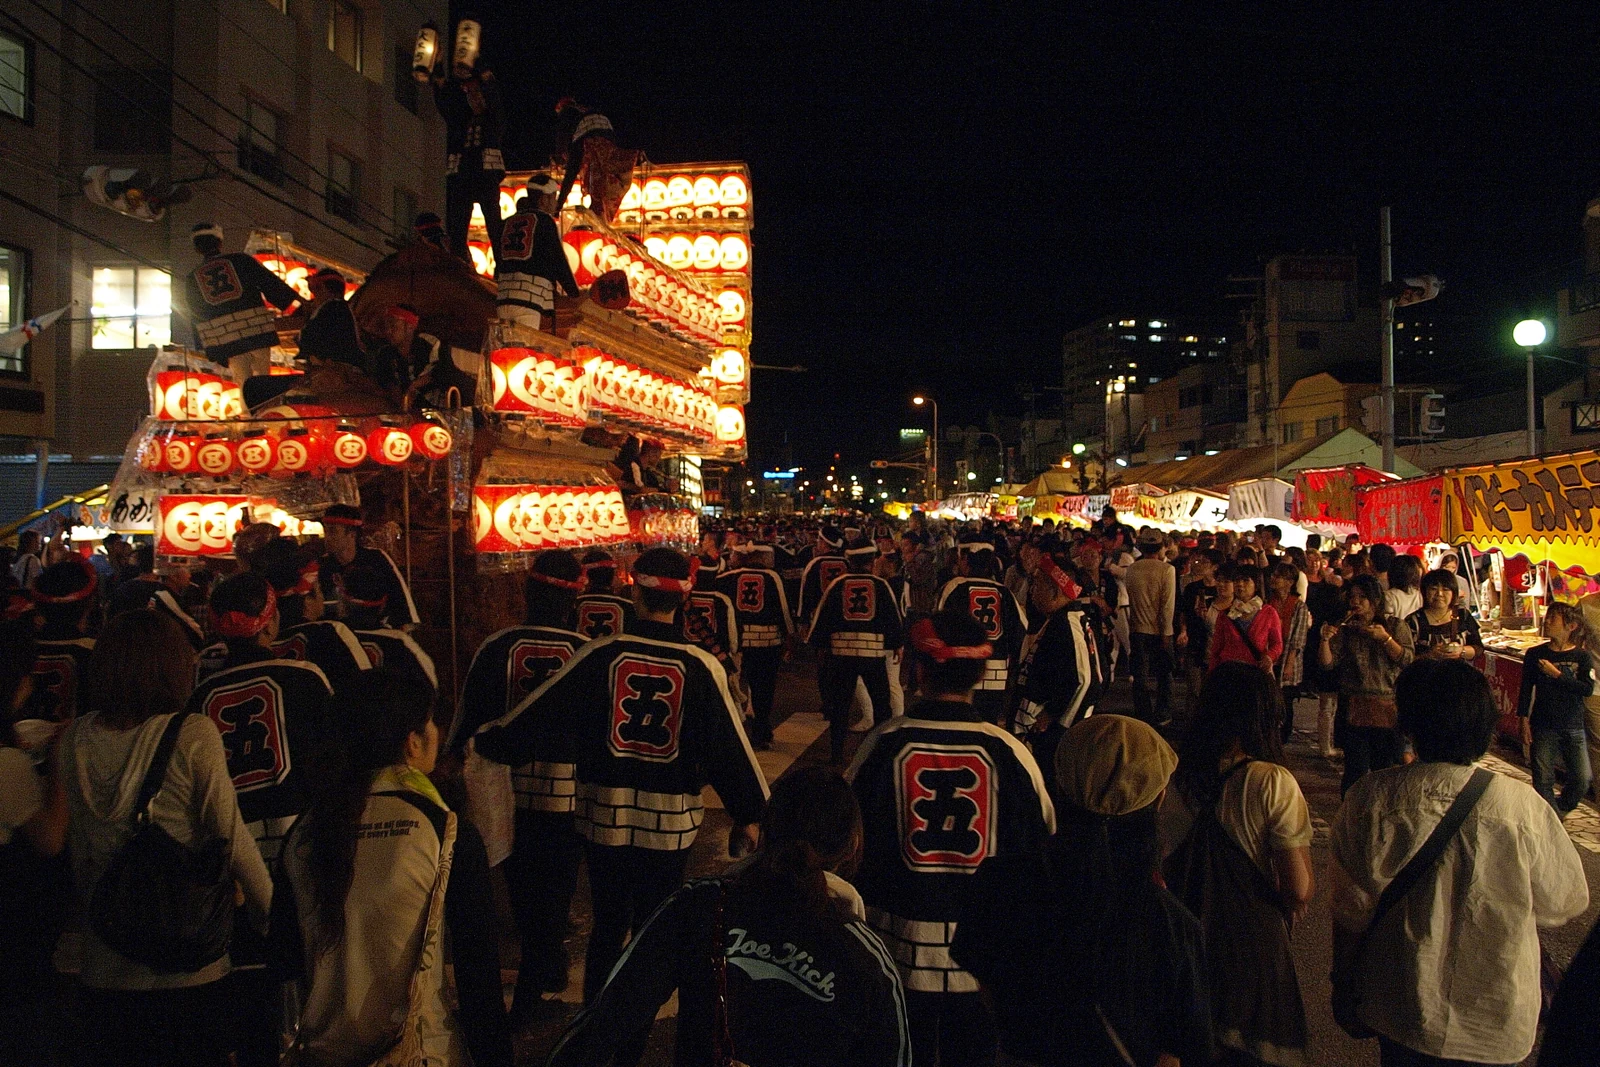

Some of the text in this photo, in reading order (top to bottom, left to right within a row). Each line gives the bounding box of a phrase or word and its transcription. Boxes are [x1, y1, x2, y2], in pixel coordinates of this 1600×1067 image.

[972, 595, 1000, 633] 五
[218, 695, 278, 781] 五
[615, 672, 677, 750] 五
[910, 765, 981, 858] 五
